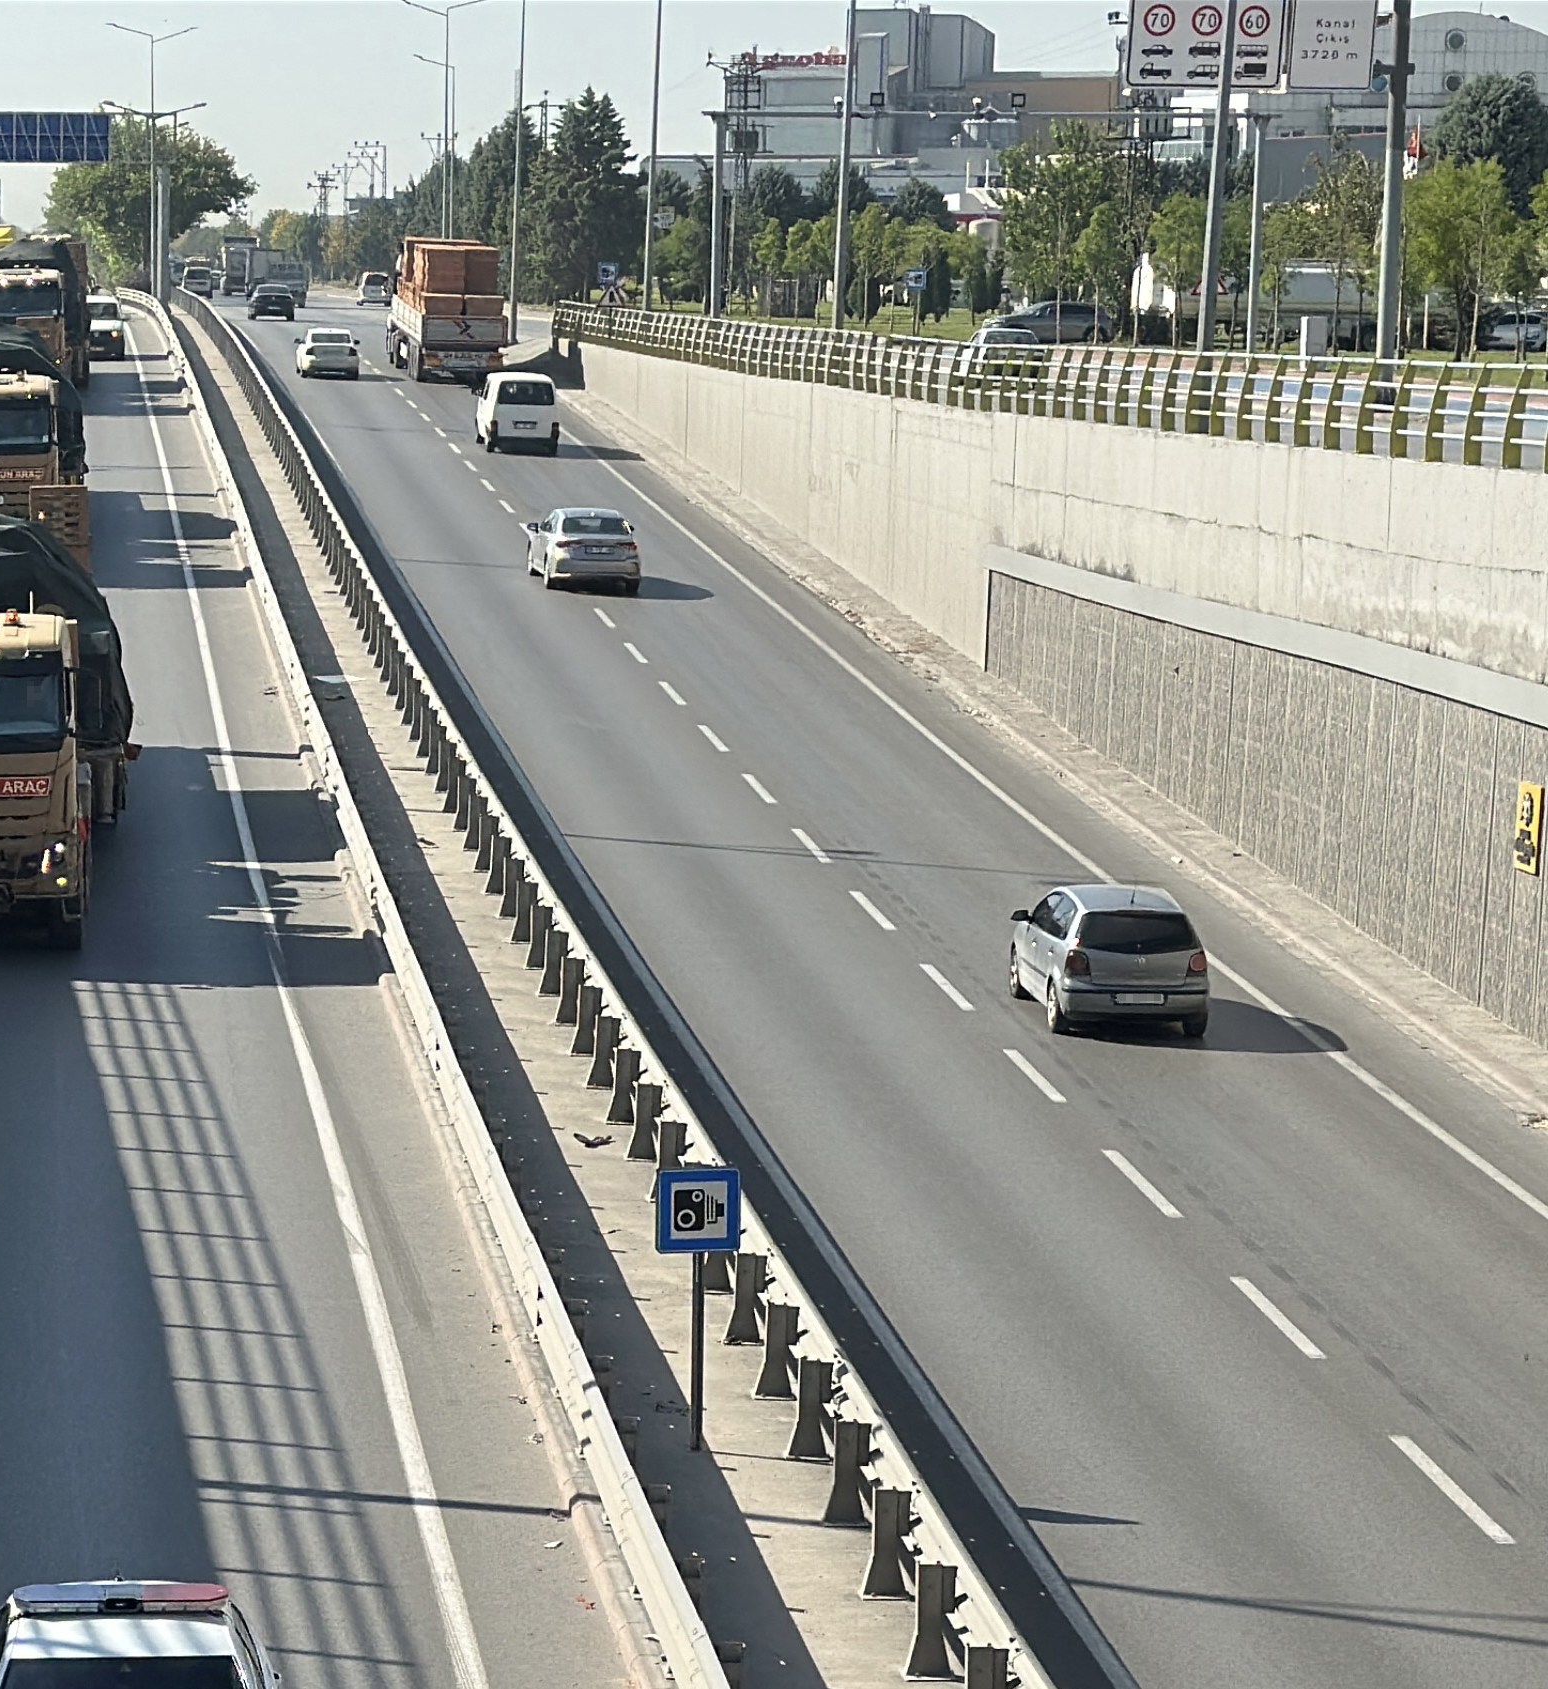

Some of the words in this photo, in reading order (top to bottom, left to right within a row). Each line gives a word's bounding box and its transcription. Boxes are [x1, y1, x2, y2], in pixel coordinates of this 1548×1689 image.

[1150, 13, 1170, 28] 70
[1198, 13, 1217, 28] 70
[1245, 14, 1265, 29] 60
[1316, 19, 1355, 29] Kanal
[1346, 52, 1358, 60] m
[2, 779, 46, 796] ARAÇ
